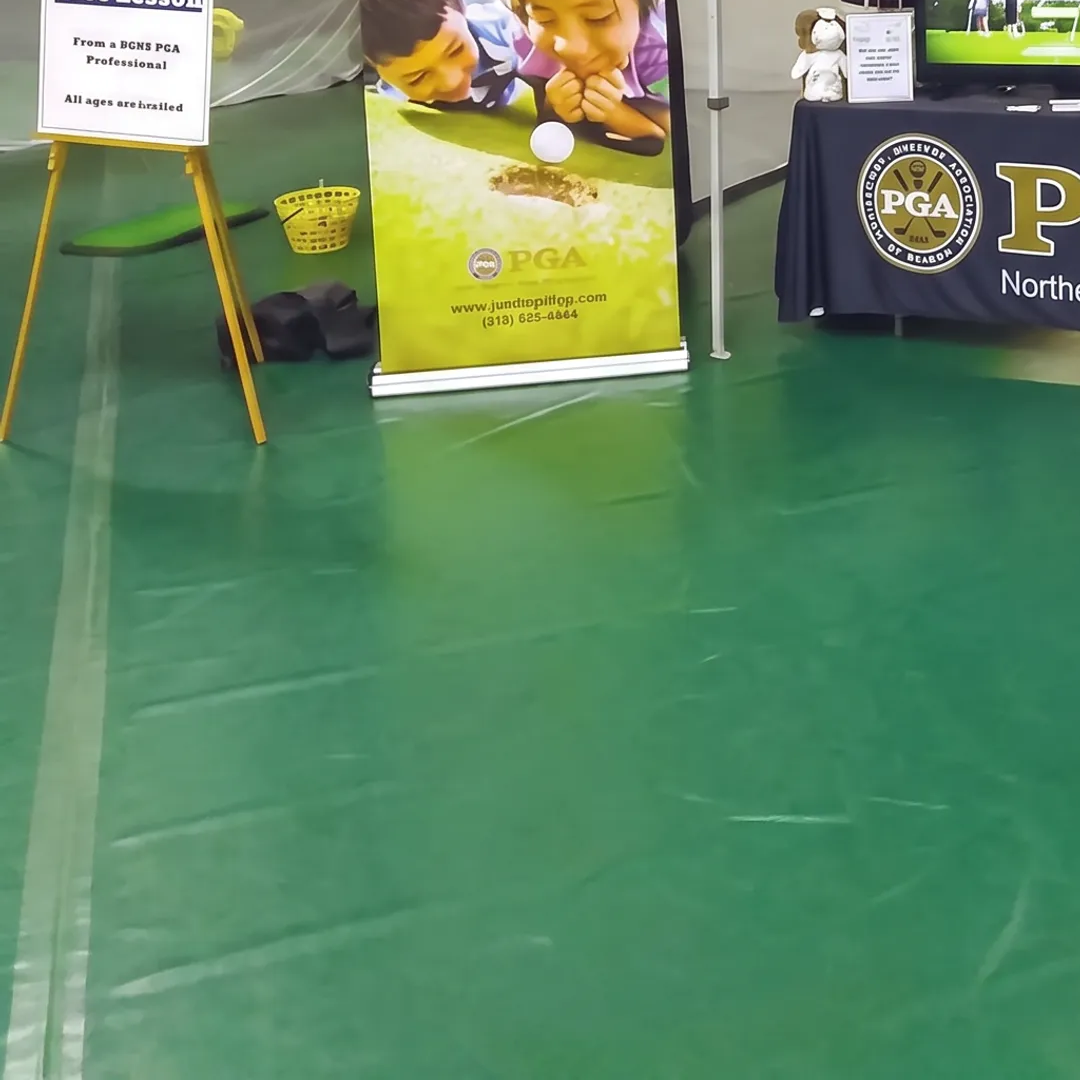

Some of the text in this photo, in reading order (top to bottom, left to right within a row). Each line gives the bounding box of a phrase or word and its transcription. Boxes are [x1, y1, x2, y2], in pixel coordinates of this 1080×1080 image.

[73, 37, 105, 48] From
[155, 43, 180, 53] PGA
[86, 55, 167, 70] Professional
[64, 94, 82, 104] All
[85, 98, 113, 107] ages
[117, 100, 136, 108] are
[880, 189, 959, 219] PGA
[509, 246, 588, 273] PGA
